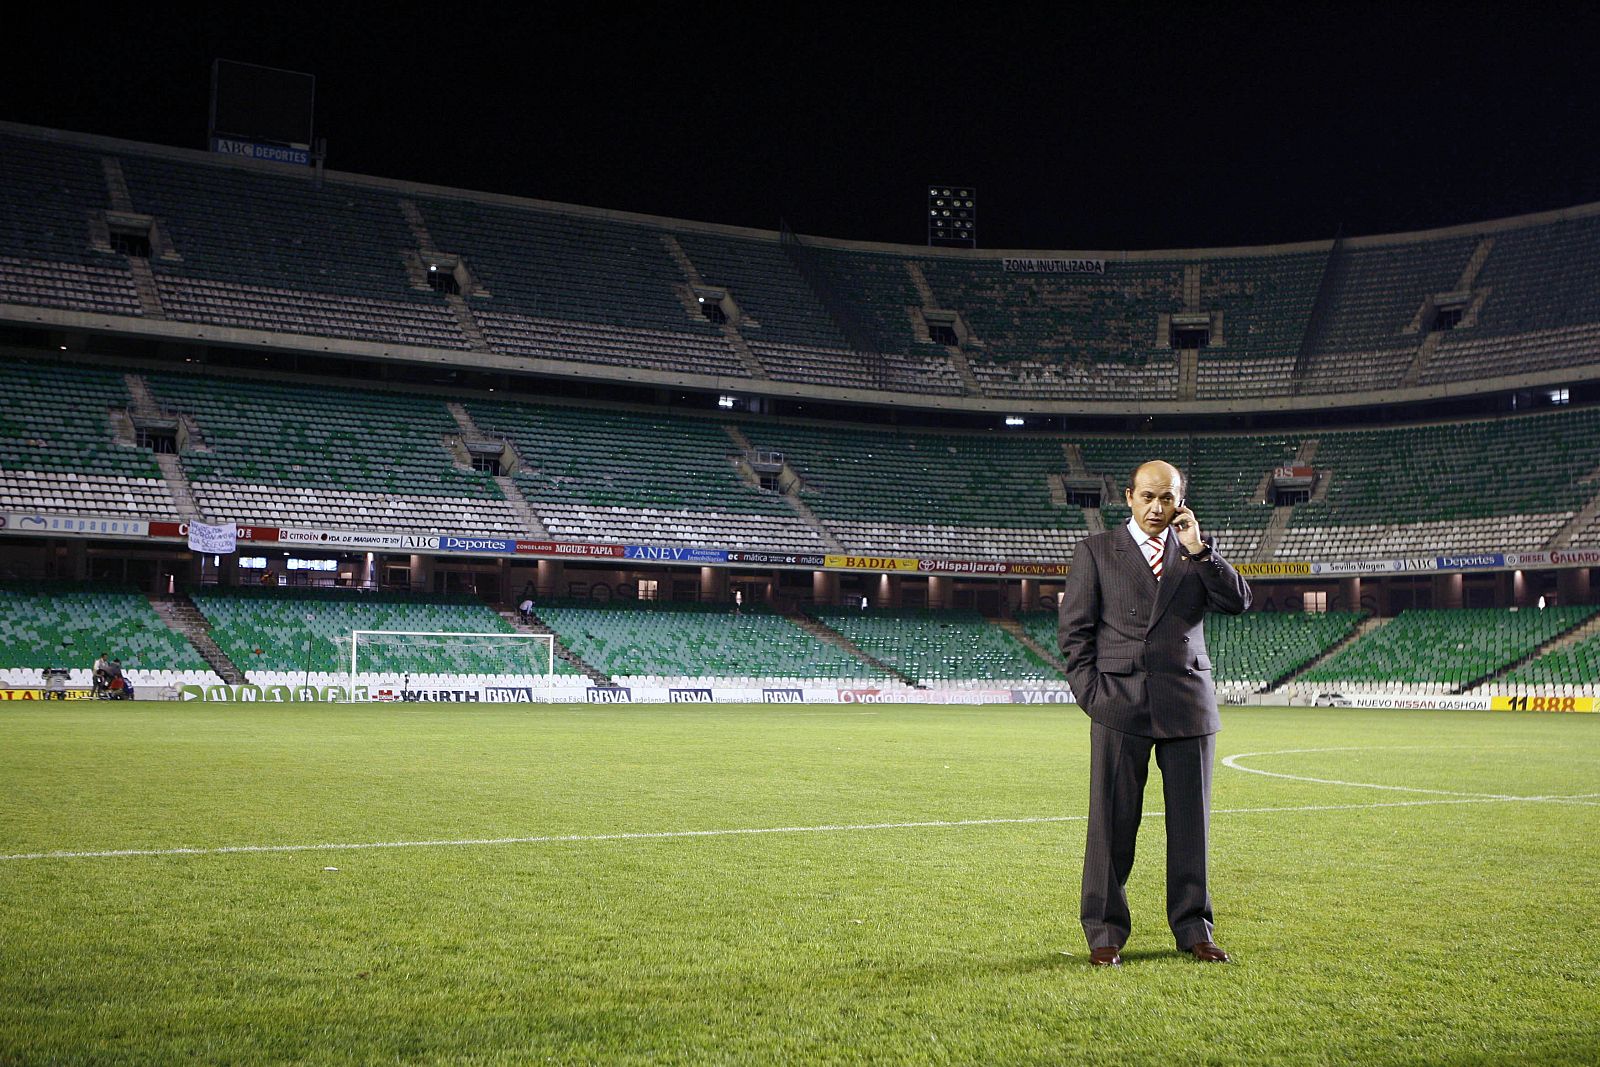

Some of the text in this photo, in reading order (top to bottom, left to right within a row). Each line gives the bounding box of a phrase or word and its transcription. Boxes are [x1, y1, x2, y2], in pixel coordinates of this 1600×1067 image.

[220, 140, 307, 163] ABC DEPORTES
[1005, 260, 1102, 273] ZONA INUTILIZADA
[289, 531, 319, 541] CITROËN
[402, 536, 506, 550] ABC Deportes
[555, 544, 588, 554] MIGUEL
[589, 545, 613, 555] TAPIA
[633, 547, 684, 560] ANEV
[845, 557, 898, 569] BADIA
[1407, 556, 1495, 571] ABC Deportes
[1519, 554, 1545, 564] DIESEL
[935, 560, 1007, 573] Hispaljarafe
[1242, 563, 1281, 574] SANCHO
[1283, 563, 1309, 574] TORO
[1329, 562, 1386, 572] Sevilla Wagen
[486, 689, 530, 702] BBVA
[587, 690, 630, 702] BBVA
[670, 691, 712, 703] BBVA
[763, 691, 801, 703] BBVA
[856, 690, 927, 703] vodafone
[1357, 700, 1392, 708] NUEVO
[1394, 700, 1436, 709] NISSAN
[1438, 701, 1487, 710] QASHQAI
[1507, 696, 1528, 711] 11
[1531, 696, 1576, 712] 888
